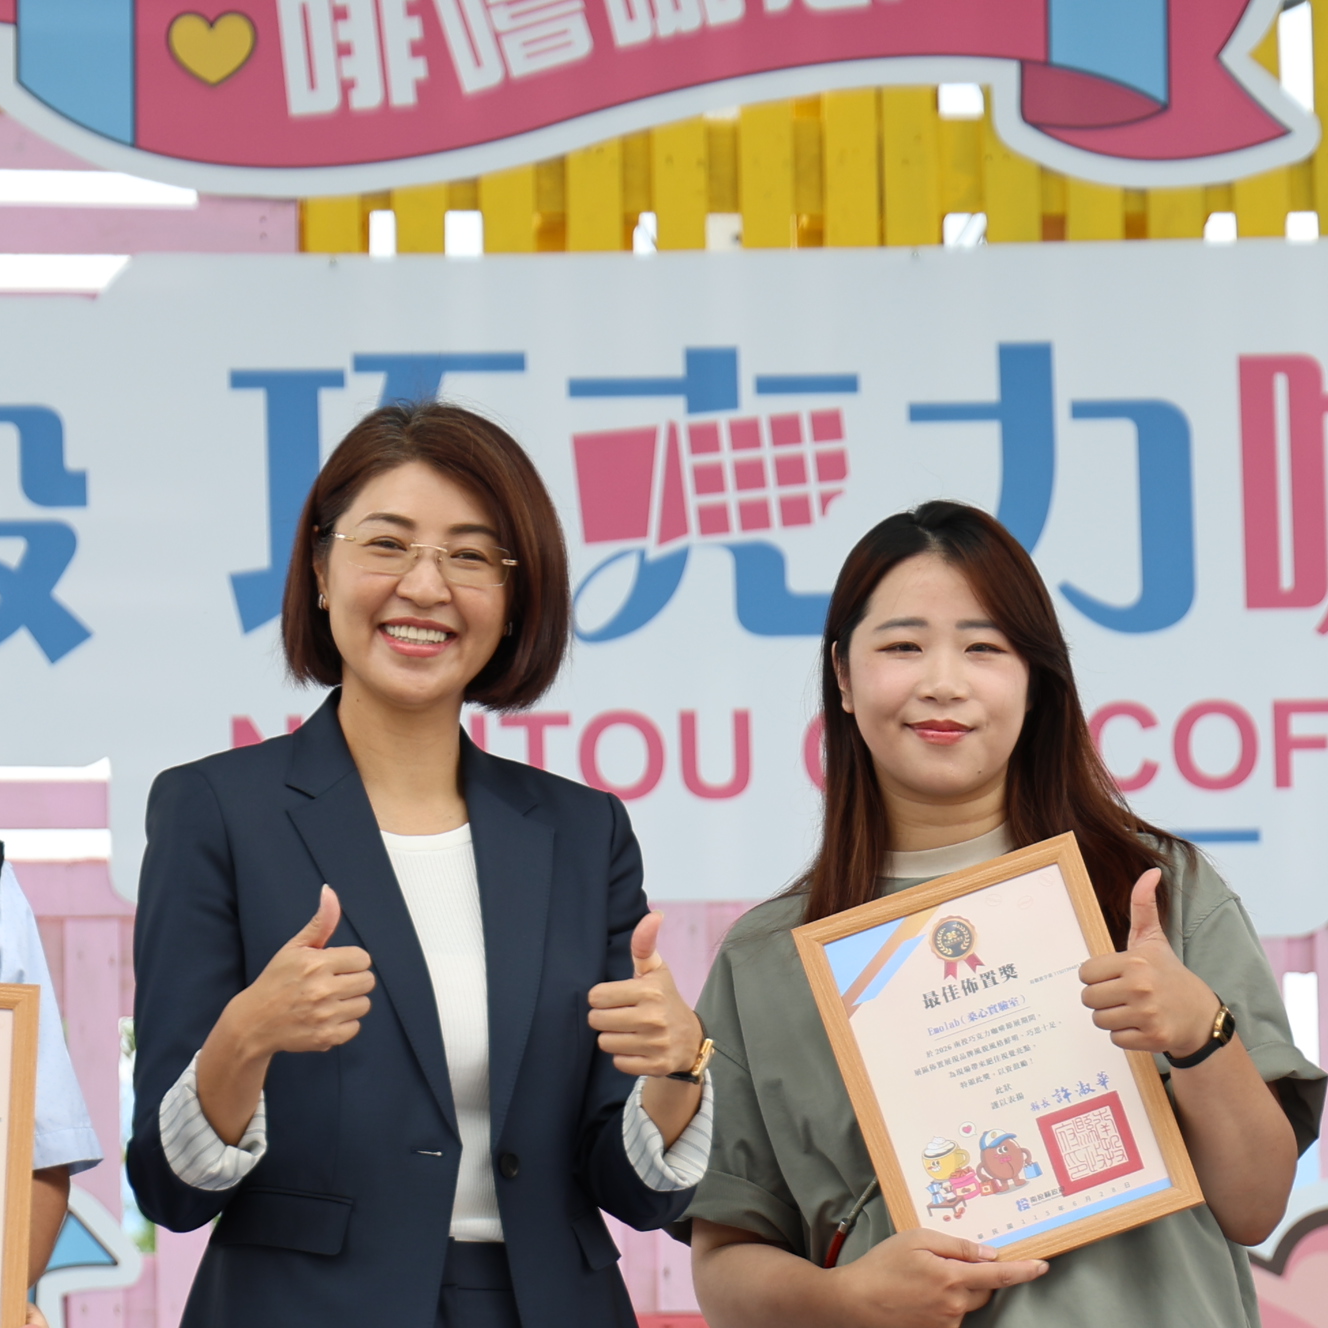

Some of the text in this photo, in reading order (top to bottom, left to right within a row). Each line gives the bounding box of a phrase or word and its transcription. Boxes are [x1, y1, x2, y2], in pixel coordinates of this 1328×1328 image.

[922, 963, 1018, 1010] 最佳佈置獎
